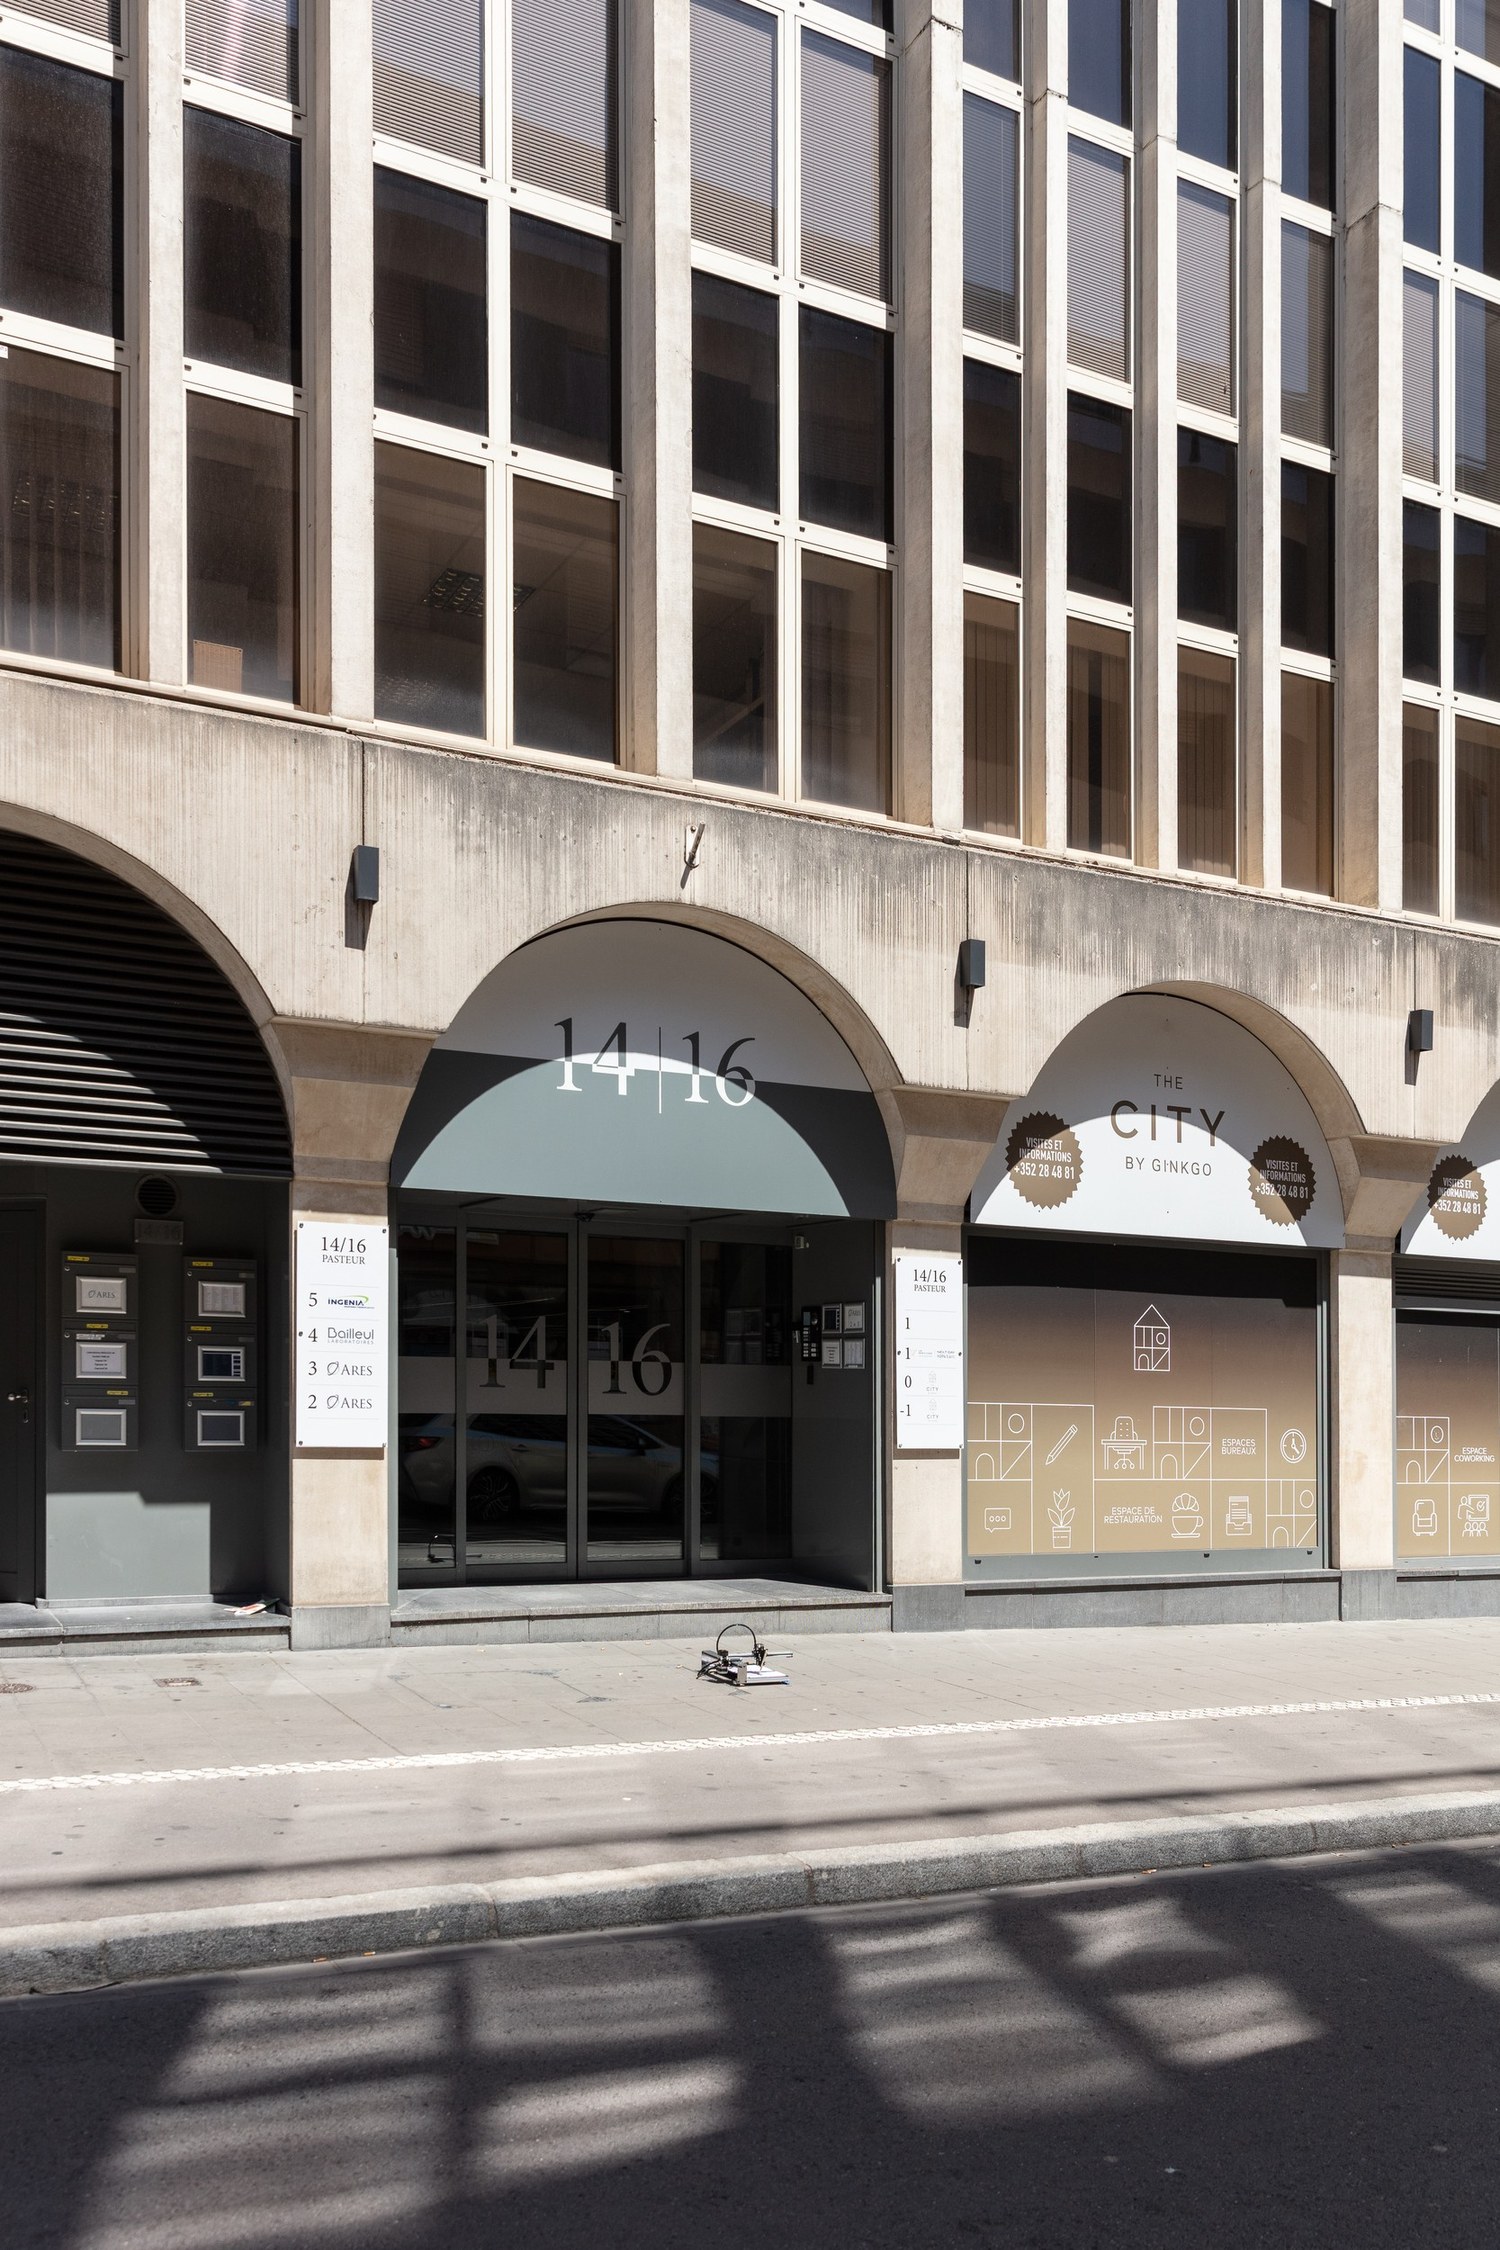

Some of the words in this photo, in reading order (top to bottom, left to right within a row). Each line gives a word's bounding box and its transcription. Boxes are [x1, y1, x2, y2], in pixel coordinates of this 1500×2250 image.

[554, 1017, 635, 1096] 14
[682, 1031, 756, 1106] 16
[1153, 1073, 1183, 1090] THE
[1110, 1100, 1225, 1147] CITY
[1025, 1137, 1053, 1150] VISITES
[1054, 1140, 1063, 1150] ET
[1019, 1148, 1072, 1163] INFORMATIONS
[1014, 1162, 1036, 1176] +352
[1038, 1164, 1049, 1177] 28
[1051, 1165, 1062, 1179] 48
[1064, 1166, 1075, 1180] 81
[1125, 1156, 1145, 1170] BY
[1151, 1159, 1212, 1177] GINKGO
[1265, 1159, 1290, 1171] VISITES
[1290, 1162, 1299, 1172] ET
[1259, 1169, 1306, 1184] INFORMATIONS
[1442, 1177, 1465, 1188] VISITES
[1465, 1180, 1472, 1188] ET
[1255, 1182, 1275, 1196] +352
[1276, 1184, 1287, 1197] 28
[1288, 1185, 1298, 1198] 48
[1299, 1186, 1309, 1199] 81
[1437, 1186, 1479, 1200] INFORMATIONS
[1433, 1201, 1451, 1212] +352
[1452, 1202, 1462, 1213] 28
[1462, 1203, 1472, 1214] 48
[1472, 1204, 1481, 1215] 81
[321, 1236, 367, 1254] 14/16
[322, 1254, 366, 1265] PASTEUR
[913, 1269, 947, 1283] 14/16
[914, 1284, 947, 1293] PASTEUR
[308, 1292, 318, 1307] 5
[327, 1298, 365, 1306] INGENIA
[905, 1317, 911, 1330] 1
[308, 1328, 318, 1343] 4
[327, 1327, 375, 1340] Bailleul
[480, 1314, 555, 1389] 14
[601, 1321, 672, 1396] 16
[905, 1347, 911, 1360] 1
[308, 1361, 318, 1376] 3
[341, 1363, 373, 1376] ARES
[904, 1375, 912, 1388] 0
[308, 1394, 318, 1409] 2
[341, 1397, 373, 1409] ARES
[900, 1404, 912, 1417] -1
[1222, 1438, 1256, 1447] ESPACES
[1221, 1446, 1257, 1455] BUREAUX
[1462, 1447, 1488, 1455] ESPACE
[1454, 1454, 1496, 1463] COWORKING
[1111, 1506, 1143, 1515] ESPACE
[1144, 1506, 1155, 1515] DE
[1103, 1515, 1163, 1524] RESTAURATION
